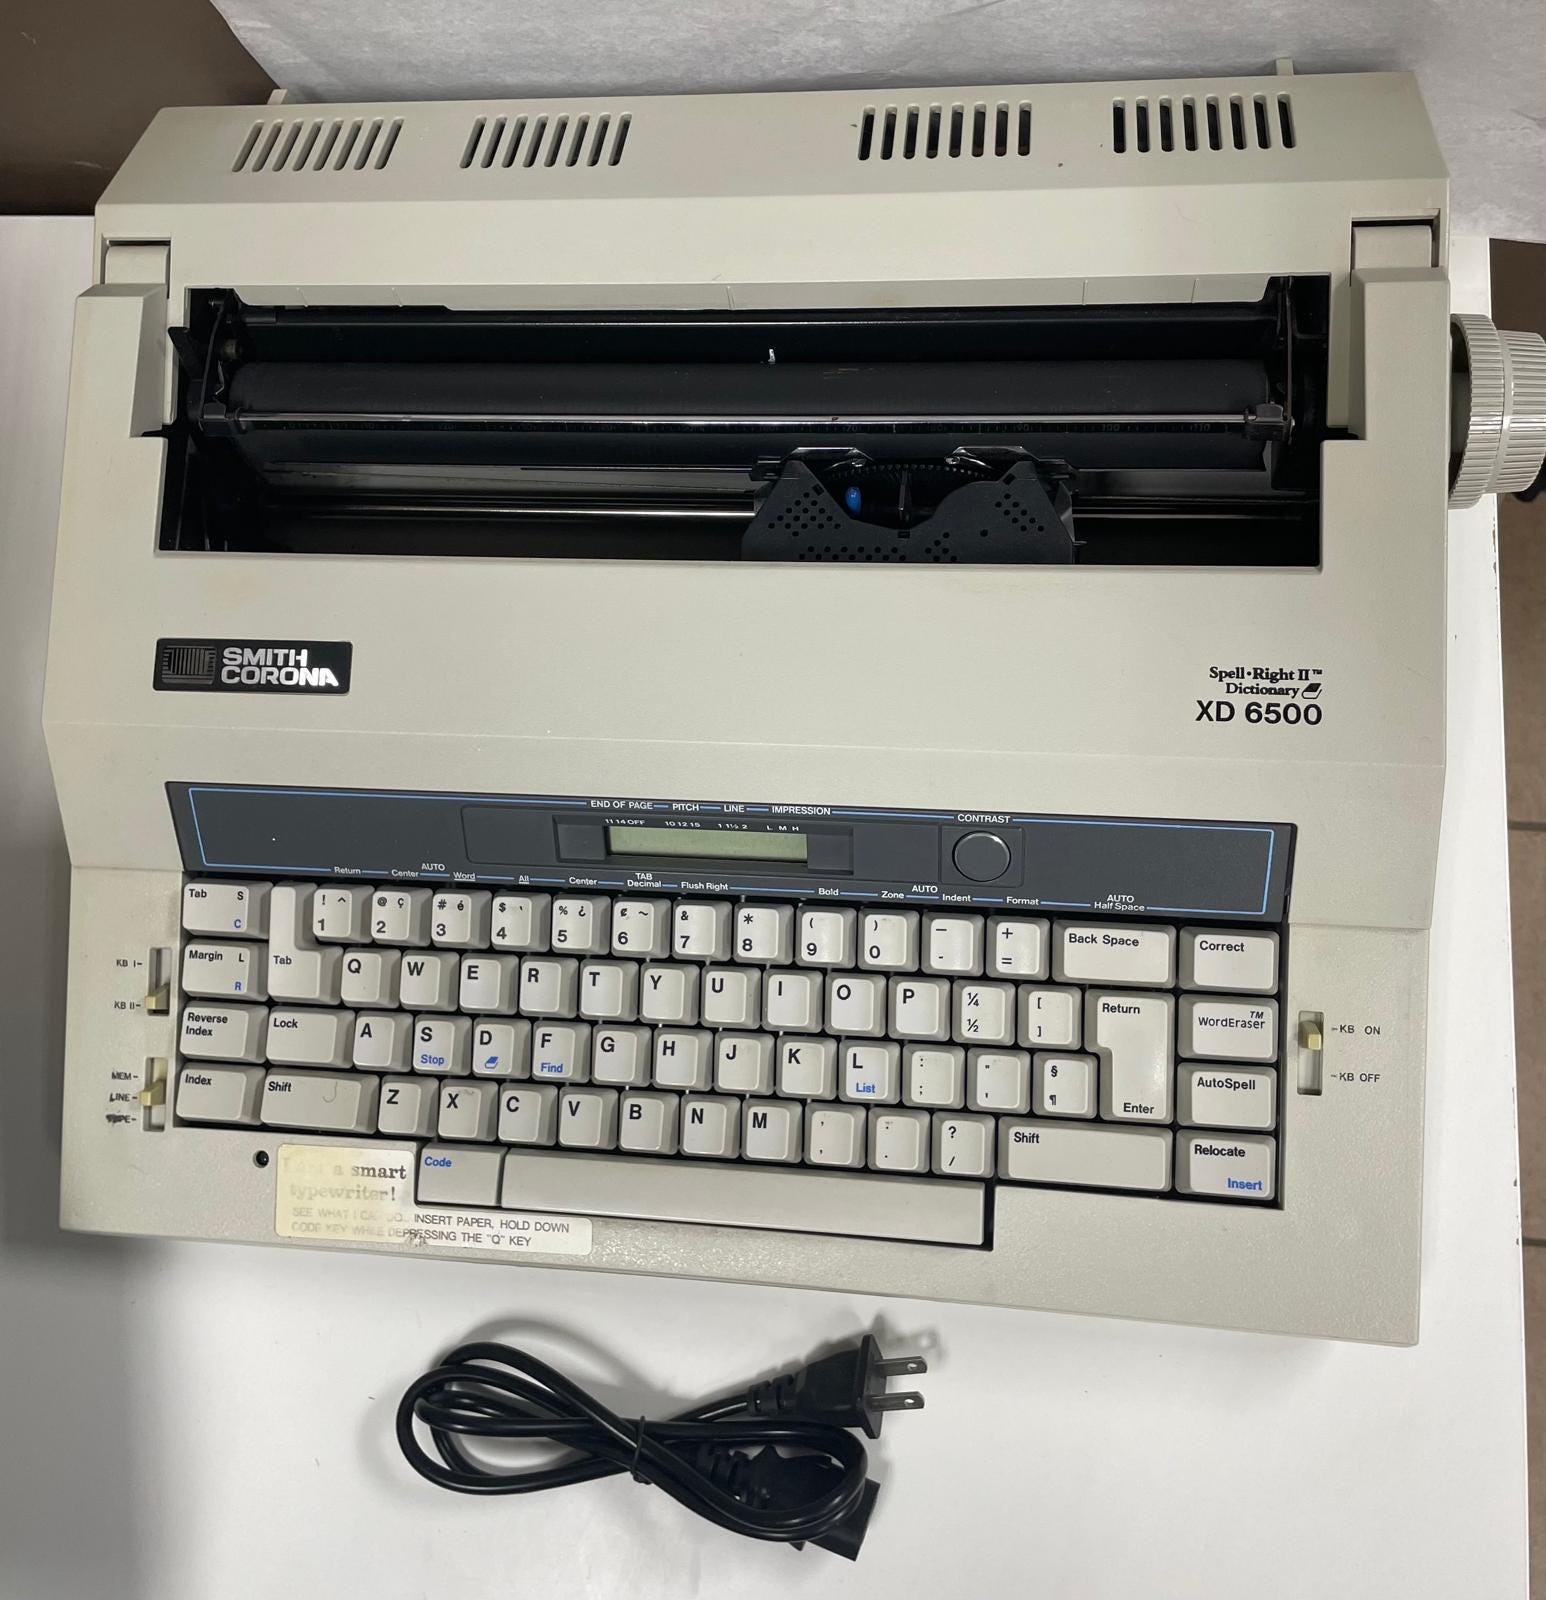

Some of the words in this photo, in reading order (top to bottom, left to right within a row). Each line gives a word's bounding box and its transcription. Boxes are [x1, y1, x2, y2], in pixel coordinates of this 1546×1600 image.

[222, 647, 308, 667] SMITH
[221, 665, 339, 687] CORONA
[1225, 682, 1300, 699] Dictionary
[1195, 700, 1235, 722] XD
[1244, 701, 1322, 726] 6500
[590, 800, 611, 809] END
[612, 800, 627, 809] OF
[628, 801, 653, 810] PAGE
[672, 803, 700, 812] PITCH
[723, 804, 745, 813] LINE
[771, 805, 831, 816] IMPRESSION
[957, 813, 1011, 824] CONTRAST
[334, 866, 361, 875] Return
[391, 868, 420, 878] Center
[421, 862, 446, 871] AUTO
[453, 871, 476, 881] Word
[518, 874, 530, 884] All
[568, 876, 598, 886] Center
[635, 872, 653, 881] TAB
[626, 879, 662, 888] Decimal
[680, 881, 705, 890] Flush
[705, 882, 729, 891] Right
[911, 885, 938, 894] AUTO
[188, 888, 208, 899] Tab
[236, 890, 244, 901] S
[818, 887, 840, 896] Bold
[881, 890, 905, 900] Zone
[942, 893, 972, 902] Indent
[376, 896, 388, 907] @
[437, 898, 447, 910] #
[1006, 896, 1040, 906] Format
[1106, 894, 1135, 903] AUTO
[498, 902, 507, 913] $
[558, 905, 568, 916] %
[1094, 901, 1114, 910] Half
[1114, 902, 1145, 912] Space
[680, 910, 690, 921] &
[233, 919, 242, 929] C
[317, 918, 326, 932] 1
[376, 920, 386, 934] 2
[436, 923, 447, 937] 3
[496, 926, 508, 940] 4
[556, 930, 568, 943] 5
[617, 931, 629, 945] 6
[1001, 927, 1013, 940] +
[679, 935, 691, 949] 7
[742, 938, 753, 952] 8
[1068, 933, 1098, 945] Back
[1102, 934, 1140, 947] Space
[1199, 940, 1245, 953] Correct
[806, 942, 818, 956] 9
[115, 959, 128, 967] KB
[188, 950, 223, 961] Margin
[238, 952, 245, 963] L
[273, 955, 292, 965] Tab
[1001, 957, 1012, 965] =
[347, 958, 362, 975] Q
[407, 961, 425, 976] W
[467, 965, 479, 980] E
[527, 967, 540, 983] R
[588, 971, 601, 987] T
[234, 981, 242, 991] R
[650, 974, 662, 990] Y
[711, 977, 724, 994] U
[778, 980, 783, 996] I
[836, 984, 852, 1001] O
[902, 988, 915, 1004] P
[114, 1001, 126, 1010] KB
[1102, 1002, 1141, 1015] Return
[187, 1012, 228, 1024] Reverse
[1249, 1010, 1264, 1019] TM
[273, 1018, 298, 1029] Lock
[1197, 1016, 1266, 1030] WordEraser
[1339, 1023, 1355, 1034] KB
[1364, 1025, 1381, 1036] ON
[185, 1025, 213, 1037] Index
[359, 1023, 373, 1038] A
[420, 1026, 433, 1042] S
[480, 1030, 493, 1045] D
[540, 1033, 552, 1048] F
[600, 1036, 615, 1053] G
[662, 1041, 676, 1056] H
[725, 1044, 737, 1060] J
[788, 1048, 801, 1064] K
[420, 1054, 445, 1066] Stop
[852, 1053, 863, 1069] L
[540, 1063, 564, 1073] Find
[1050, 1065, 1058, 1078] §
[111, 1071, 132, 1080] MEM
[185, 1074, 212, 1085] Index
[1338, 1072, 1354, 1083] KB
[1359, 1072, 1381, 1084] OFF
[267, 1081, 292, 1093] Shift
[855, 1083, 876, 1093] List
[1197, 1077, 1256, 1091] AutoSpell
[109, 1093, 131, 1102] LINE
[386, 1089, 399, 1105] Z
[446, 1093, 460, 1109] X
[506, 1096, 520, 1112] C
[568, 1101, 581, 1117] V
[1123, 1102, 1155, 1115] Enter
[629, 1104, 642, 1120] B
[691, 1108, 704, 1125] N
[752, 1112, 768, 1129] M
[948, 1126, 957, 1139] ?
[1013, 1131, 1040, 1144] Shift
[1194, 1144, 1246, 1158] Relocate
[424, 1156, 452, 1168] Code
[351, 1164, 407, 1180] smart
[1227, 1177, 1263, 1191] Insert
[289, 1183, 396, 1202] typewriter!
[414, 1213, 452, 1226] INSERT
[456, 1216, 495, 1230] PAPER,
[500, 1219, 530, 1231] HOLD
[534, 1221, 570, 1234] DOWN
[461, 1232, 482, 1243] THE
[509, 1235, 532, 1247] KEY
